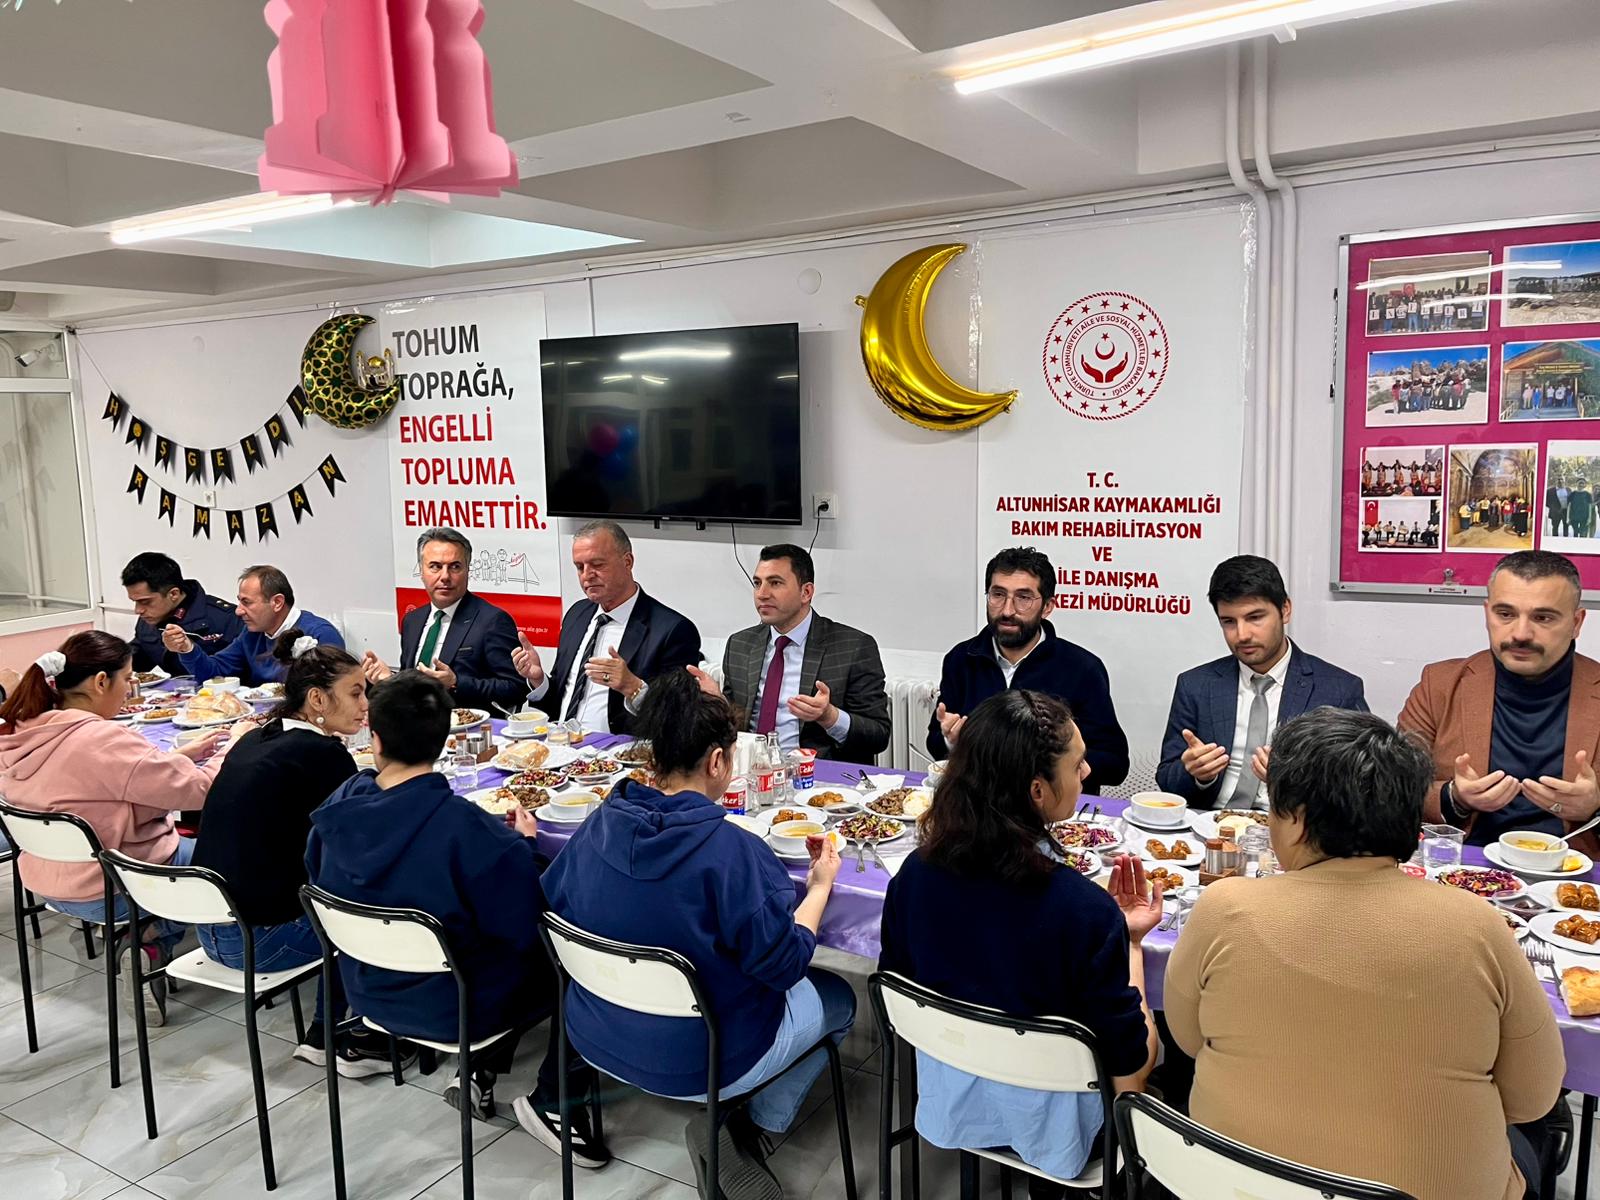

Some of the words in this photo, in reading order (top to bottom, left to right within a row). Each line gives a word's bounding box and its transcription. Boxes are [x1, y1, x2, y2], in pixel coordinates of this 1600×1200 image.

[392, 324, 479, 358] TOHUM
[1080, 318, 1096, 331] AİLE
[1096, 315, 1105, 323] VE
[1106, 315, 1131, 329] SOSYAL
[1130, 325, 1146, 366] HİZMETLER
[395, 362, 514, 401] TOPRAĞA,
[400, 406, 493, 443] ENGELLİ
[401, 457, 515, 485] TOPLUMA
[134, 460, 337, 530] RAMAZAN
[996, 493, 1090, 512] ALTUNHİSAR
[1094, 494, 1221, 513] KAYMAKAMLIĞI
[404, 494, 547, 530] EMANETTİR.
[1011, 520, 1058, 536] BAKIM
[1062, 519, 1202, 539] REHABİLİTASYON
[1092, 546, 1112, 562] VE
[1056, 567, 1081, 585] İLE
[1085, 570, 1159, 589] DANIŞMA
[1088, 592, 1191, 615] MÜDÜRLÜĞÜ
